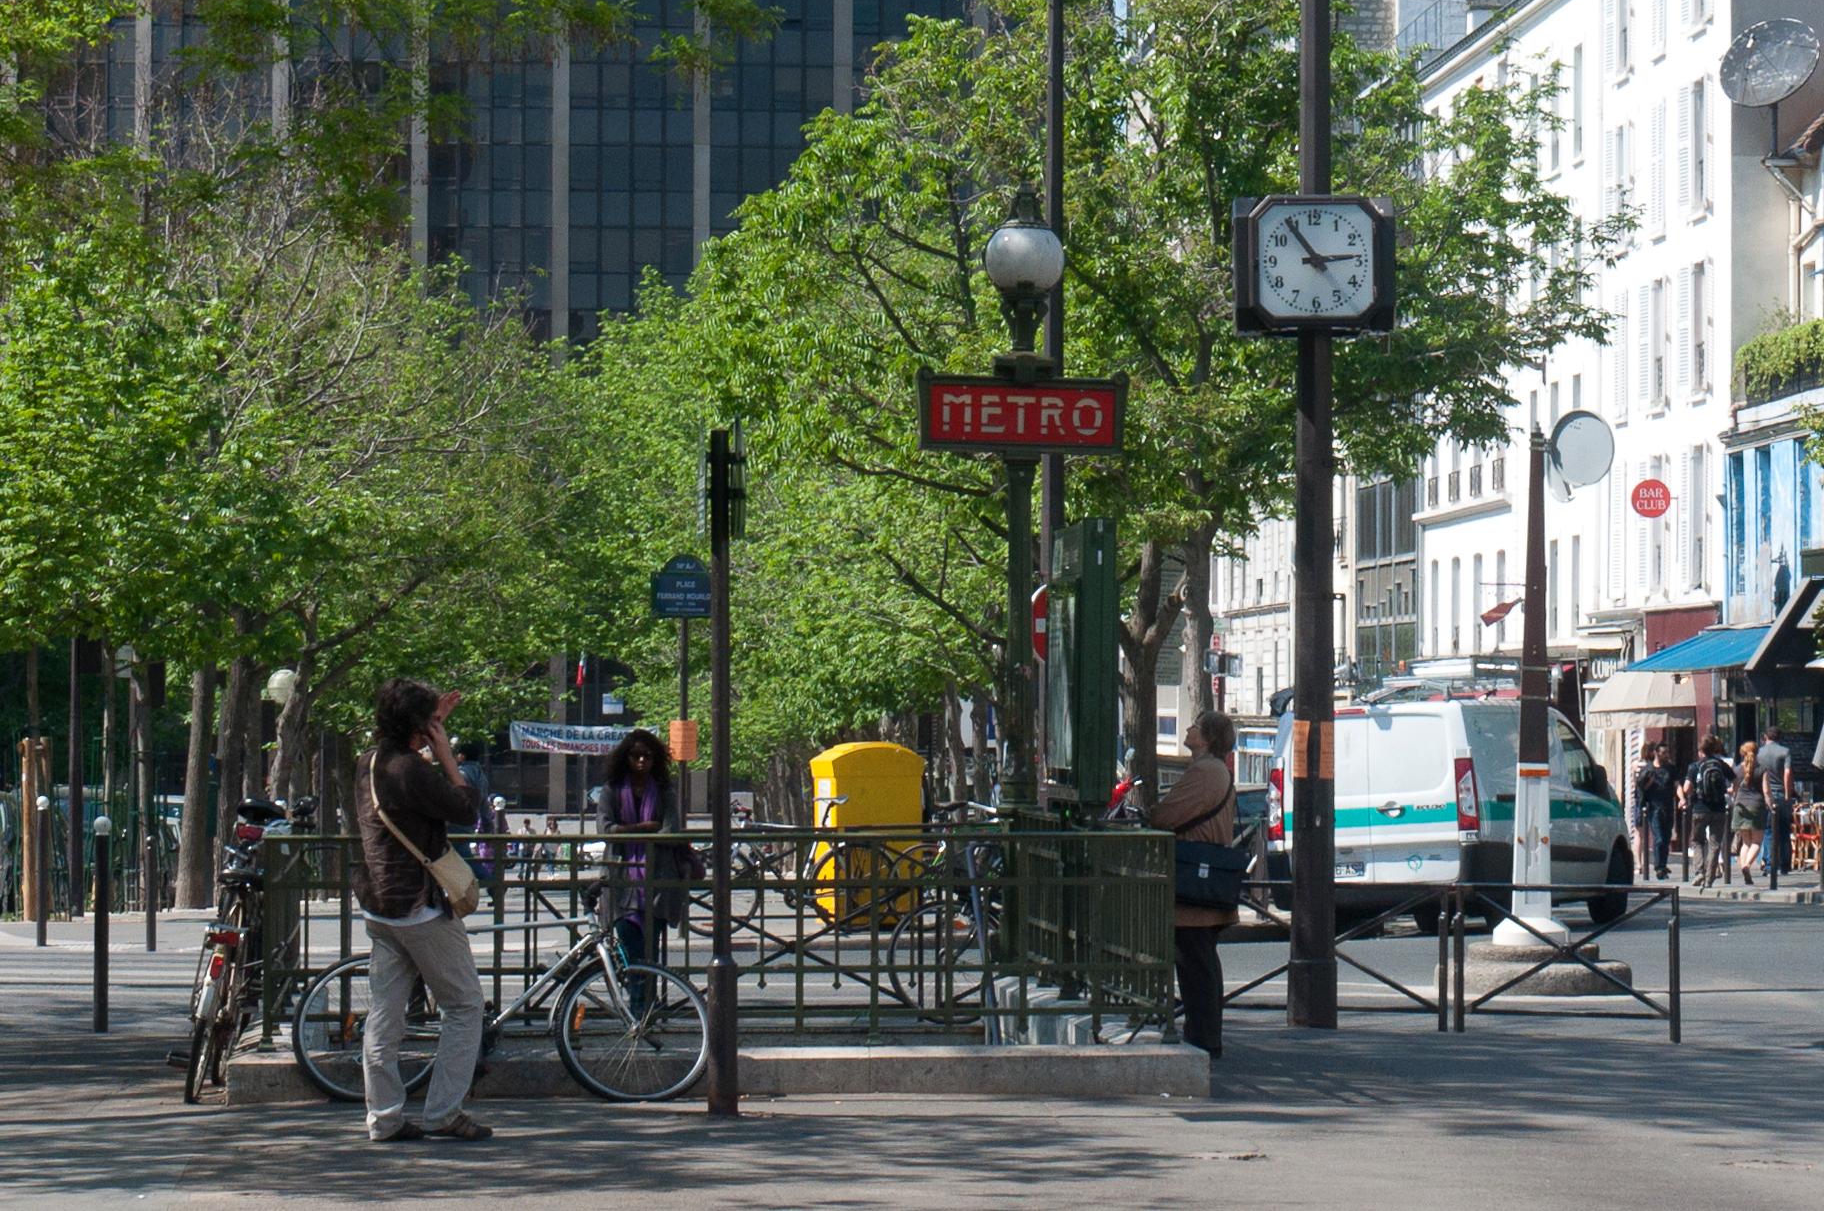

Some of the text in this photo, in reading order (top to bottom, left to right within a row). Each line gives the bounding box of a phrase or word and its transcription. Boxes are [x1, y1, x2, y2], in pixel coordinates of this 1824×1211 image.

[1308, 213, 1321, 226] 12
[1334, 219, 1339, 232] 1
[1274, 234, 1288, 247] 10
[1348, 233, 1357, 246] 2
[1269, 256, 1278, 268] 9
[1355, 255, 1363, 267] 3
[1275, 276, 1284, 288] 8
[1348, 275, 1358, 288] 4
[1292, 290, 1300, 303] 7
[1312, 297, 1321, 309] 6
[1333, 290, 1341, 303] 5
[942, 393, 1104, 436] METRO
[1639, 488, 1664, 499] BAR
[1636, 499, 1667, 510] CLUB
[675, 580, 696, 588] PLACE
[566, 729, 579, 740] DE
[582, 730, 594, 740] LA
[522, 739, 540, 750] TOUS
[557, 741, 600, 753] DIMANCHES
